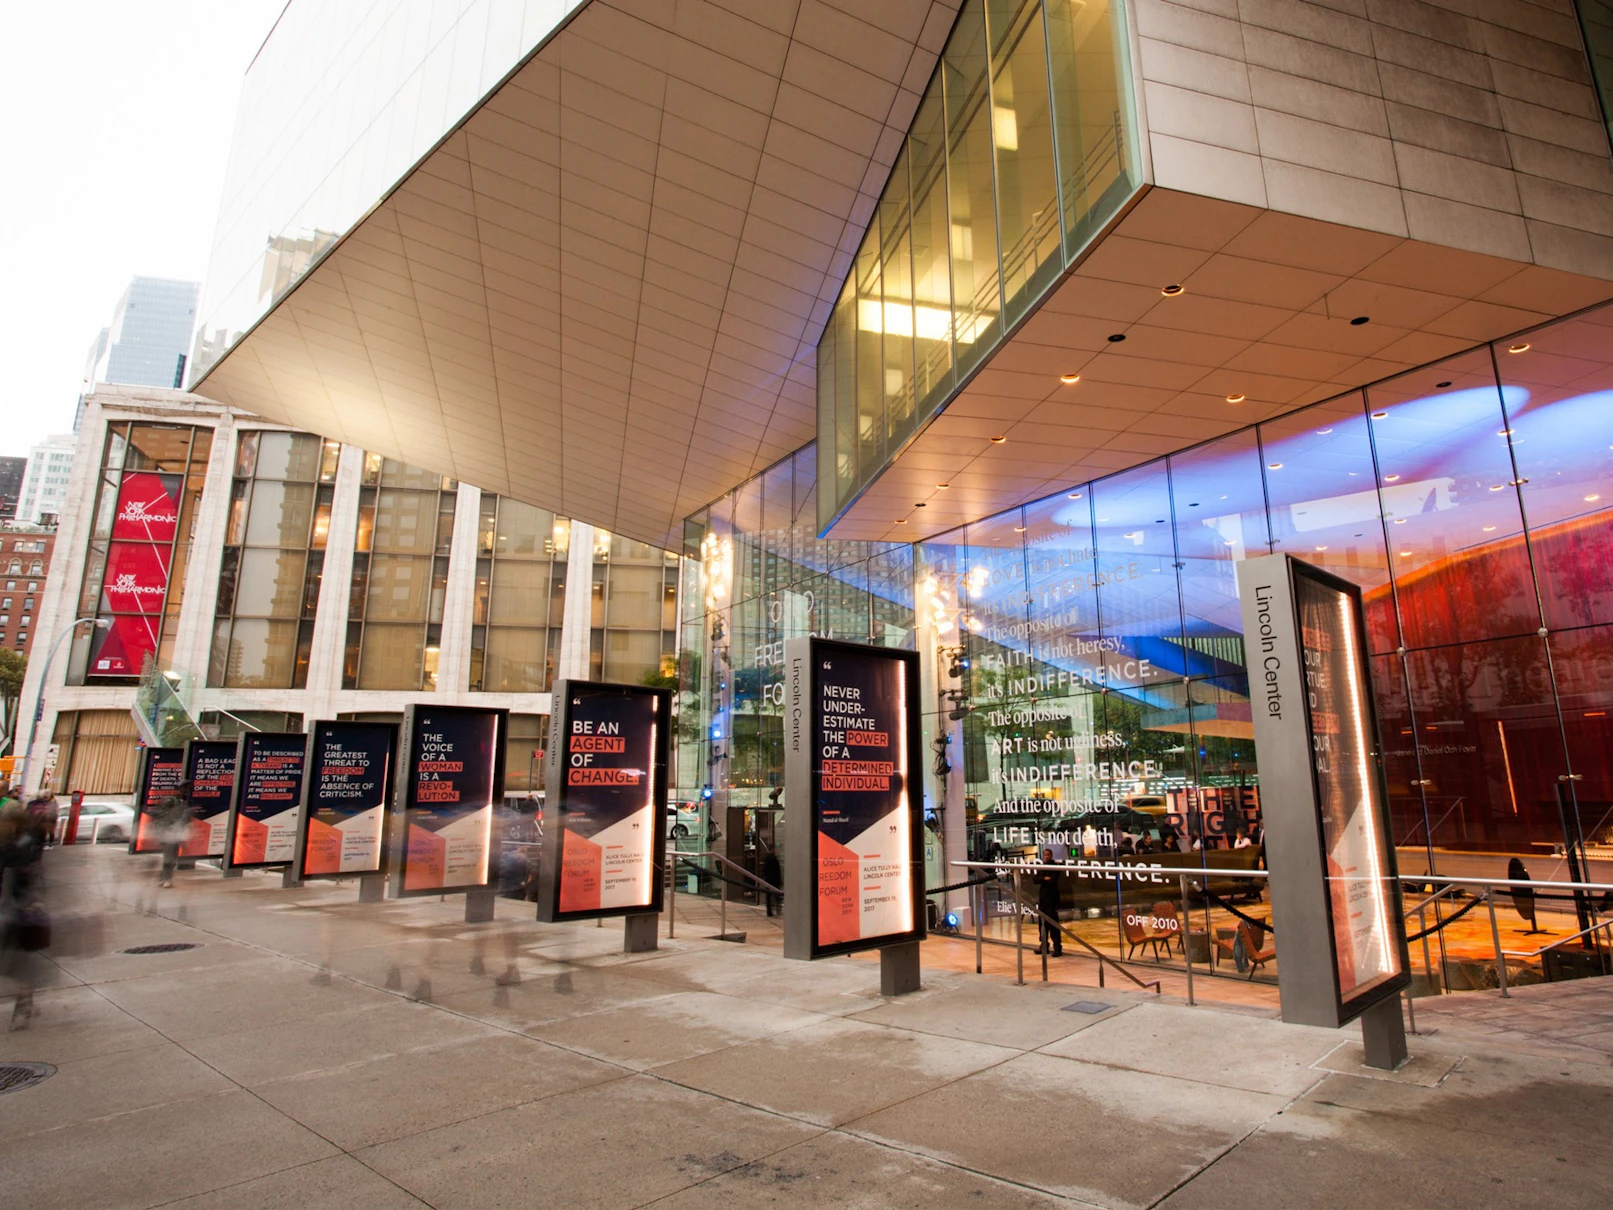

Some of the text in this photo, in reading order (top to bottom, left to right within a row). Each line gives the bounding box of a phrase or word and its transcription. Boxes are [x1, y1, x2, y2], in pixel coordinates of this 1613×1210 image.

[1059, 519, 1072, 538] of
[1031, 560, 1041, 574] is
[1044, 555, 1065, 571] not
[1002, 563, 1143, 611] INDIFFERENCE.
[771, 591, 814, 623] OO
[985, 608, 1078, 642] The opposite of
[986, 636, 1125, 670] FAITH is not heresy,
[1256, 585, 1282, 720] Lincoln Center
[988, 659, 1157, 698] it's INDIFFERENCE.
[824, 685, 859, 699] NEVER
[793, 658, 801, 752] Lincoln Center
[824, 700, 865, 714] UNDER-
[824, 716, 875, 730] ESTIMATE
[988, 712, 1011, 726] The
[1013, 708, 1068, 728] opposite
[573, 721, 618, 734] BE AN
[423, 734, 442, 742] THE
[572, 738, 623, 750] AGENT
[823, 731, 886, 744] THE POWER
[992, 732, 1126, 754] ART is not ugliness,
[423, 744, 453, 752] VOICE
[823, 746, 850, 758] OF A
[421, 753, 436, 761] OF
[571, 754, 593, 767] OF
[824, 762, 891, 774] DETERMINED
[992, 760, 1161, 784] it's INDIFFERENCE.
[570, 770, 638, 783] CHANGE.
[823, 776, 888, 789] INDIVIDUAL.
[418, 792, 458, 800] LUTION.
[993, 794, 1119, 817] And the opposite of
[993, 827, 1117, 848] LIFE is not deth,
[567, 848, 587, 856] OSLO
[564, 859, 595, 867] REEDOM
[823, 857, 844, 866] OSLO
[820, 871, 852, 882] REEDOM
[1014, 856, 1170, 883] INDFERENCE.
[820, 886, 848, 896] FORUM
[997, 902, 1011, 913] Elie
[1127, 915, 1178, 930] OFF 2010
